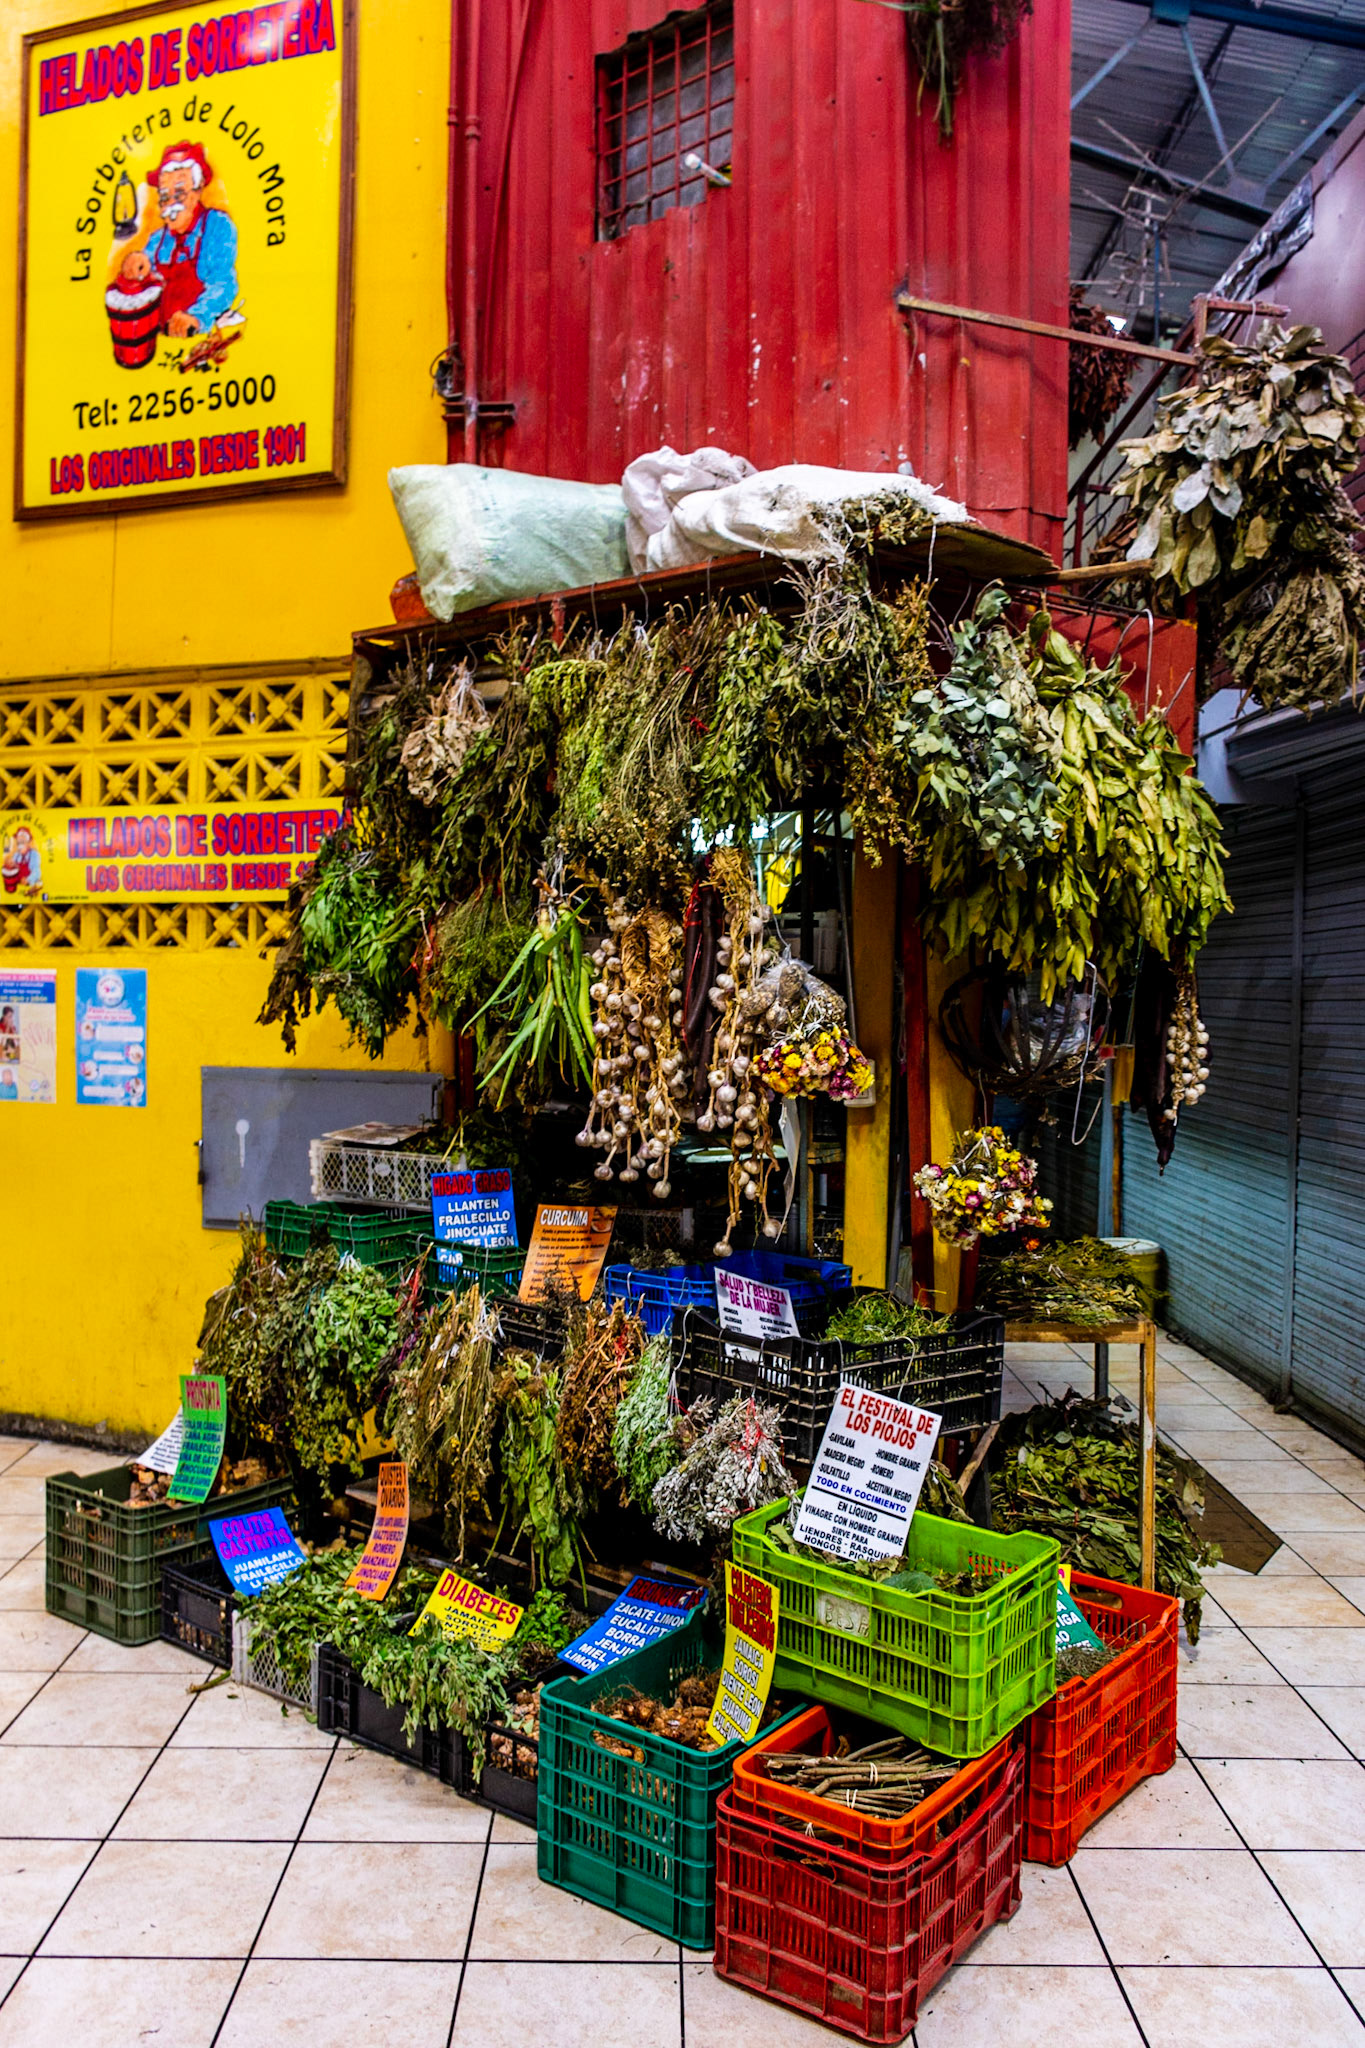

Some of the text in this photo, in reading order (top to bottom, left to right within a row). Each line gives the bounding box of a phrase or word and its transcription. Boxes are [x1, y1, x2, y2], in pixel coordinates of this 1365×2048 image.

[39, 0, 335, 116] HELADOS DE SORBETERA
[71, 95, 286, 281] La Sorbetera de Lolo Mora
[74, 374, 276, 430] Tel: 2256-5000
[50, 421, 307, 495] LOS ORIGINALES DESDE 1901
[68, 815, 171, 859] HELADOS
[175, 814, 208, 857] DE
[212, 809, 352, 856] SORBETER
[86, 864, 119, 892] LOS
[122, 863, 228, 891] ORIGINALES
[231, 861, 291, 890] DESDE
[433, 1171, 511, 1196] HIGADO GRASO
[438, 1210, 511, 1226] FRAILECILLO
[448, 1198, 499, 1213] LLANTEN
[540, 1209, 589, 1227] CURCUMA
[444, 1223, 508, 1239] JINOCUATE
[484, 1236, 515, 1248] LEON
[719, 1272, 787, 1305] SALUD Y BELLEZA
[729, 1290, 782, 1317] DE LA MUJER
[840, 1387, 935, 1435] EL FESTIVAL DE
[845, 1411, 917, 1450] LOS PIOJOS
[847, 1455, 865, 1469] NEGRO
[898, 1456, 921, 1472] GRANDE
[380, 1487, 405, 1508] OVARIOS
[816, 1475, 907, 1513] TODO EN COCIMIENTO
[837, 1501, 847, 1512] EN
[892, 1489, 912, 1503] NEGRO
[222, 1512, 274, 1540] COLITIS
[799, 1524, 842, 1545] LIENDRES
[805, 1504, 904, 1546] VINAGRE CON HOMBRE GRANDE
[831, 1526, 869, 1545] SIRVE PARA
[219, 1527, 291, 1560] GASTRITIS
[372, 1543, 396, 1554] ROMERO
[804, 1534, 841, 1553] HONGOS
[234, 1549, 295, 1574] JUANILAMA
[234, 1556, 304, 1584] FRAILECILLO
[361, 1555, 397, 1568] MANZANILLA
[438, 1573, 519, 1625] DIABETES
[444, 1606, 497, 1629] JAMAICA
[445, 1614, 491, 1633] SOROSI
[610, 1615, 672, 1638] EUCALIPT
[614, 1602, 686, 1628] ZACATE LIMON
[578, 1643, 606, 1662] MIEL
[594, 1638, 636, 1657] JENJI
[734, 1635, 764, 1672] JAMAICA
[563, 1650, 600, 1672] LIMON
[734, 1656, 759, 1690] SOROSI
[721, 1669, 763, 1719] DIENTE LEON
[721, 1693, 752, 1734] GUARUMO
